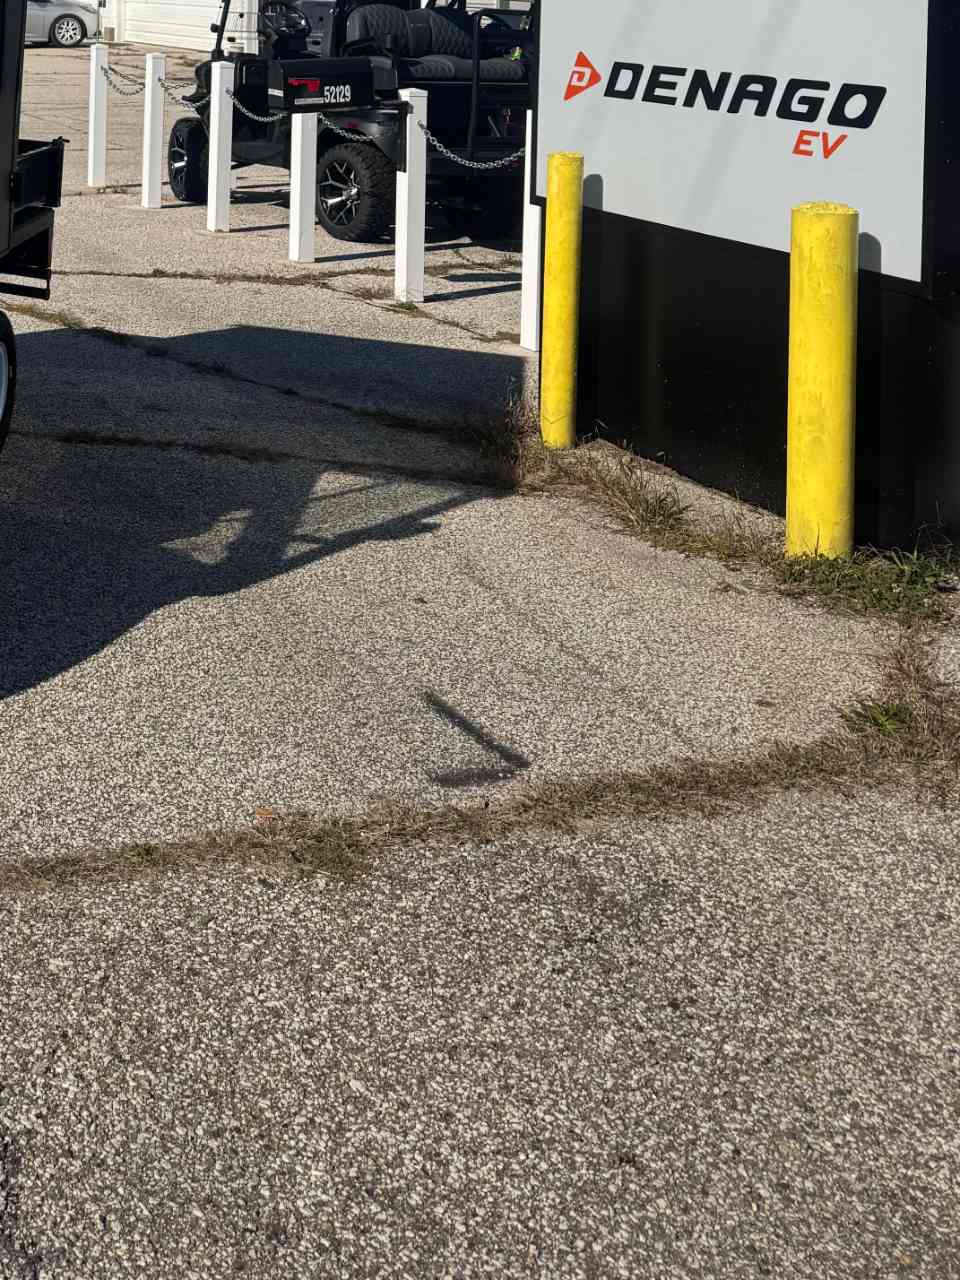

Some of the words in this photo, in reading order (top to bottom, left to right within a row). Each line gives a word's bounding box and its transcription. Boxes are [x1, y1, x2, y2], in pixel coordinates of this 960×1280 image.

[323, 84, 352, 104] 52129
[603, 61, 888, 130] DENAGO
[792, 129, 848, 160] EV
